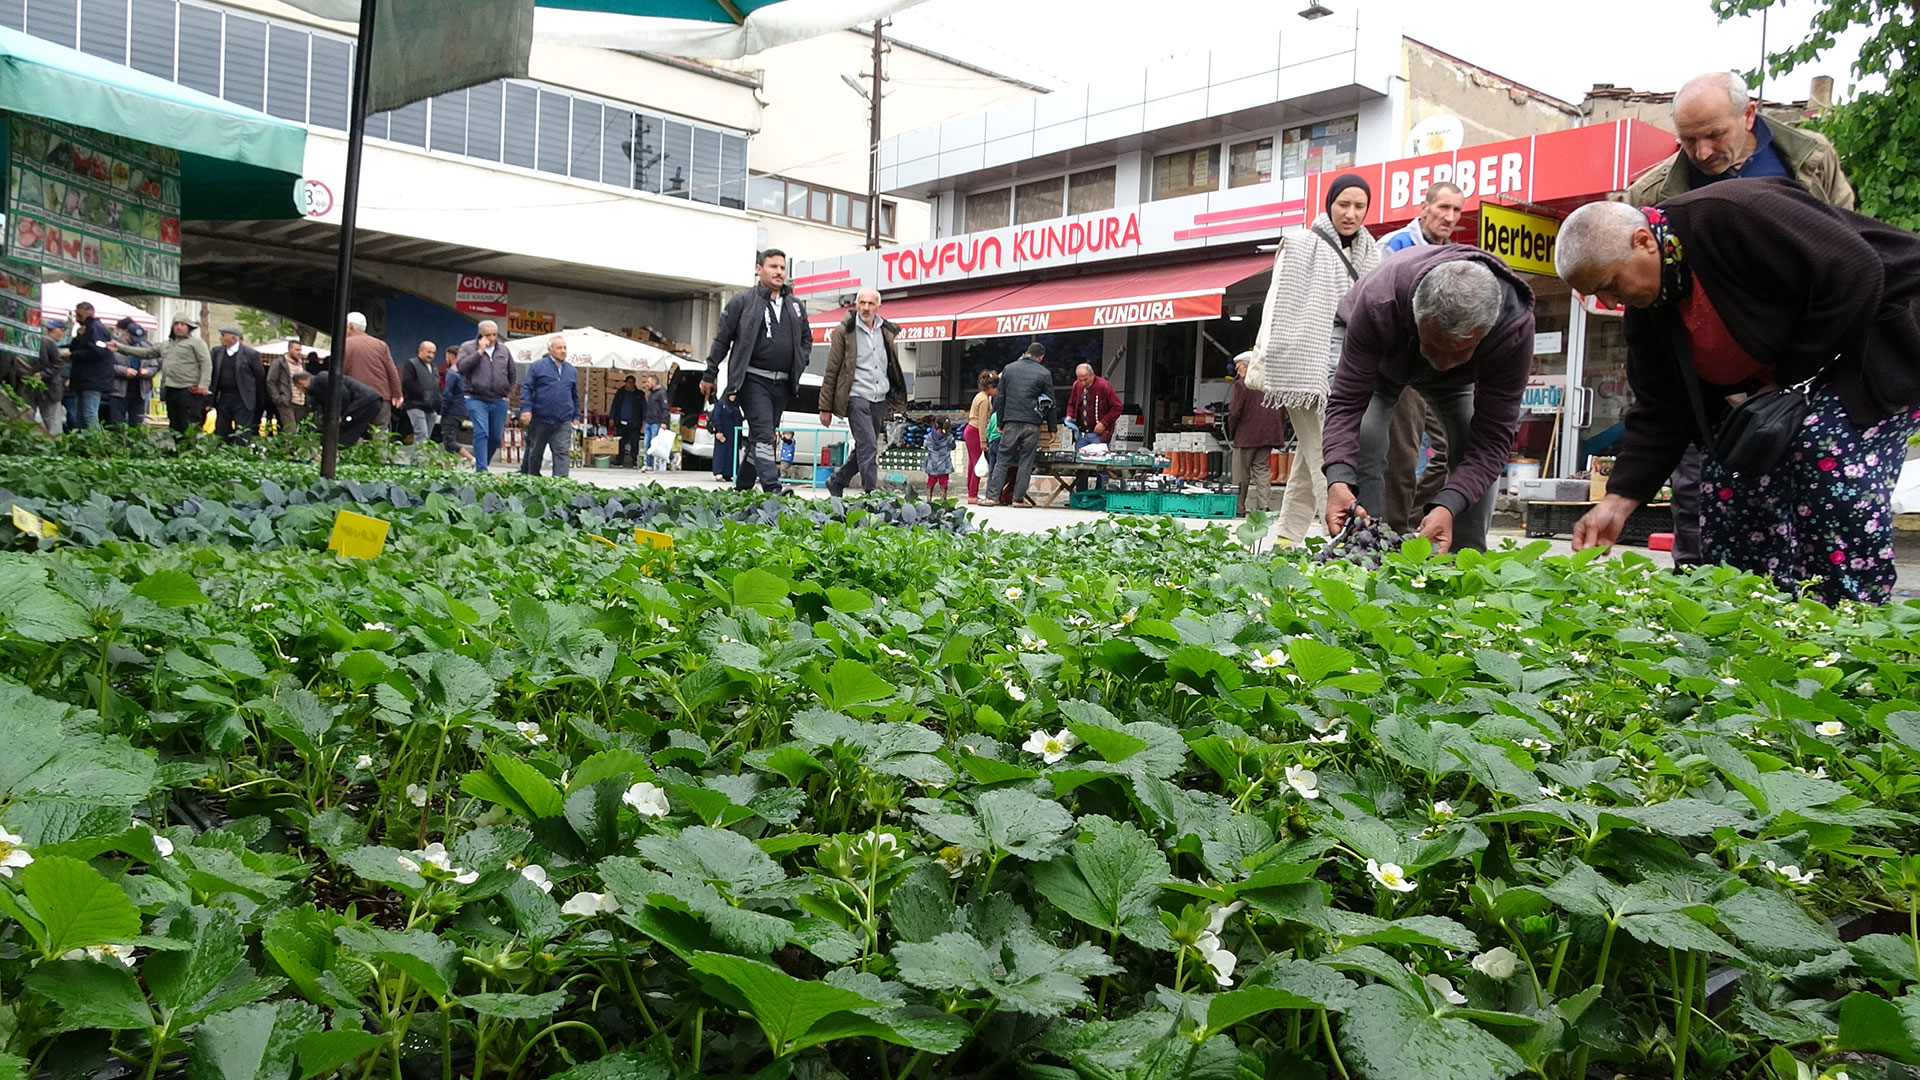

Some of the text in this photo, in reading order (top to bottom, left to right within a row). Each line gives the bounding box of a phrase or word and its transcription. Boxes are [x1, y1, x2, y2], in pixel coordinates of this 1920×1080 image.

[882, 212, 1142, 283] TAYFUN KUNDURA
[1484, 217, 1555, 263] berber
[463, 276, 504, 293] GÜVEN
[907, 327, 922, 339] 228
[924, 326, 934, 338] 88
[935, 325, 946, 338] 79
[996, 300, 1175, 333] TAYFUN KUNDURA
